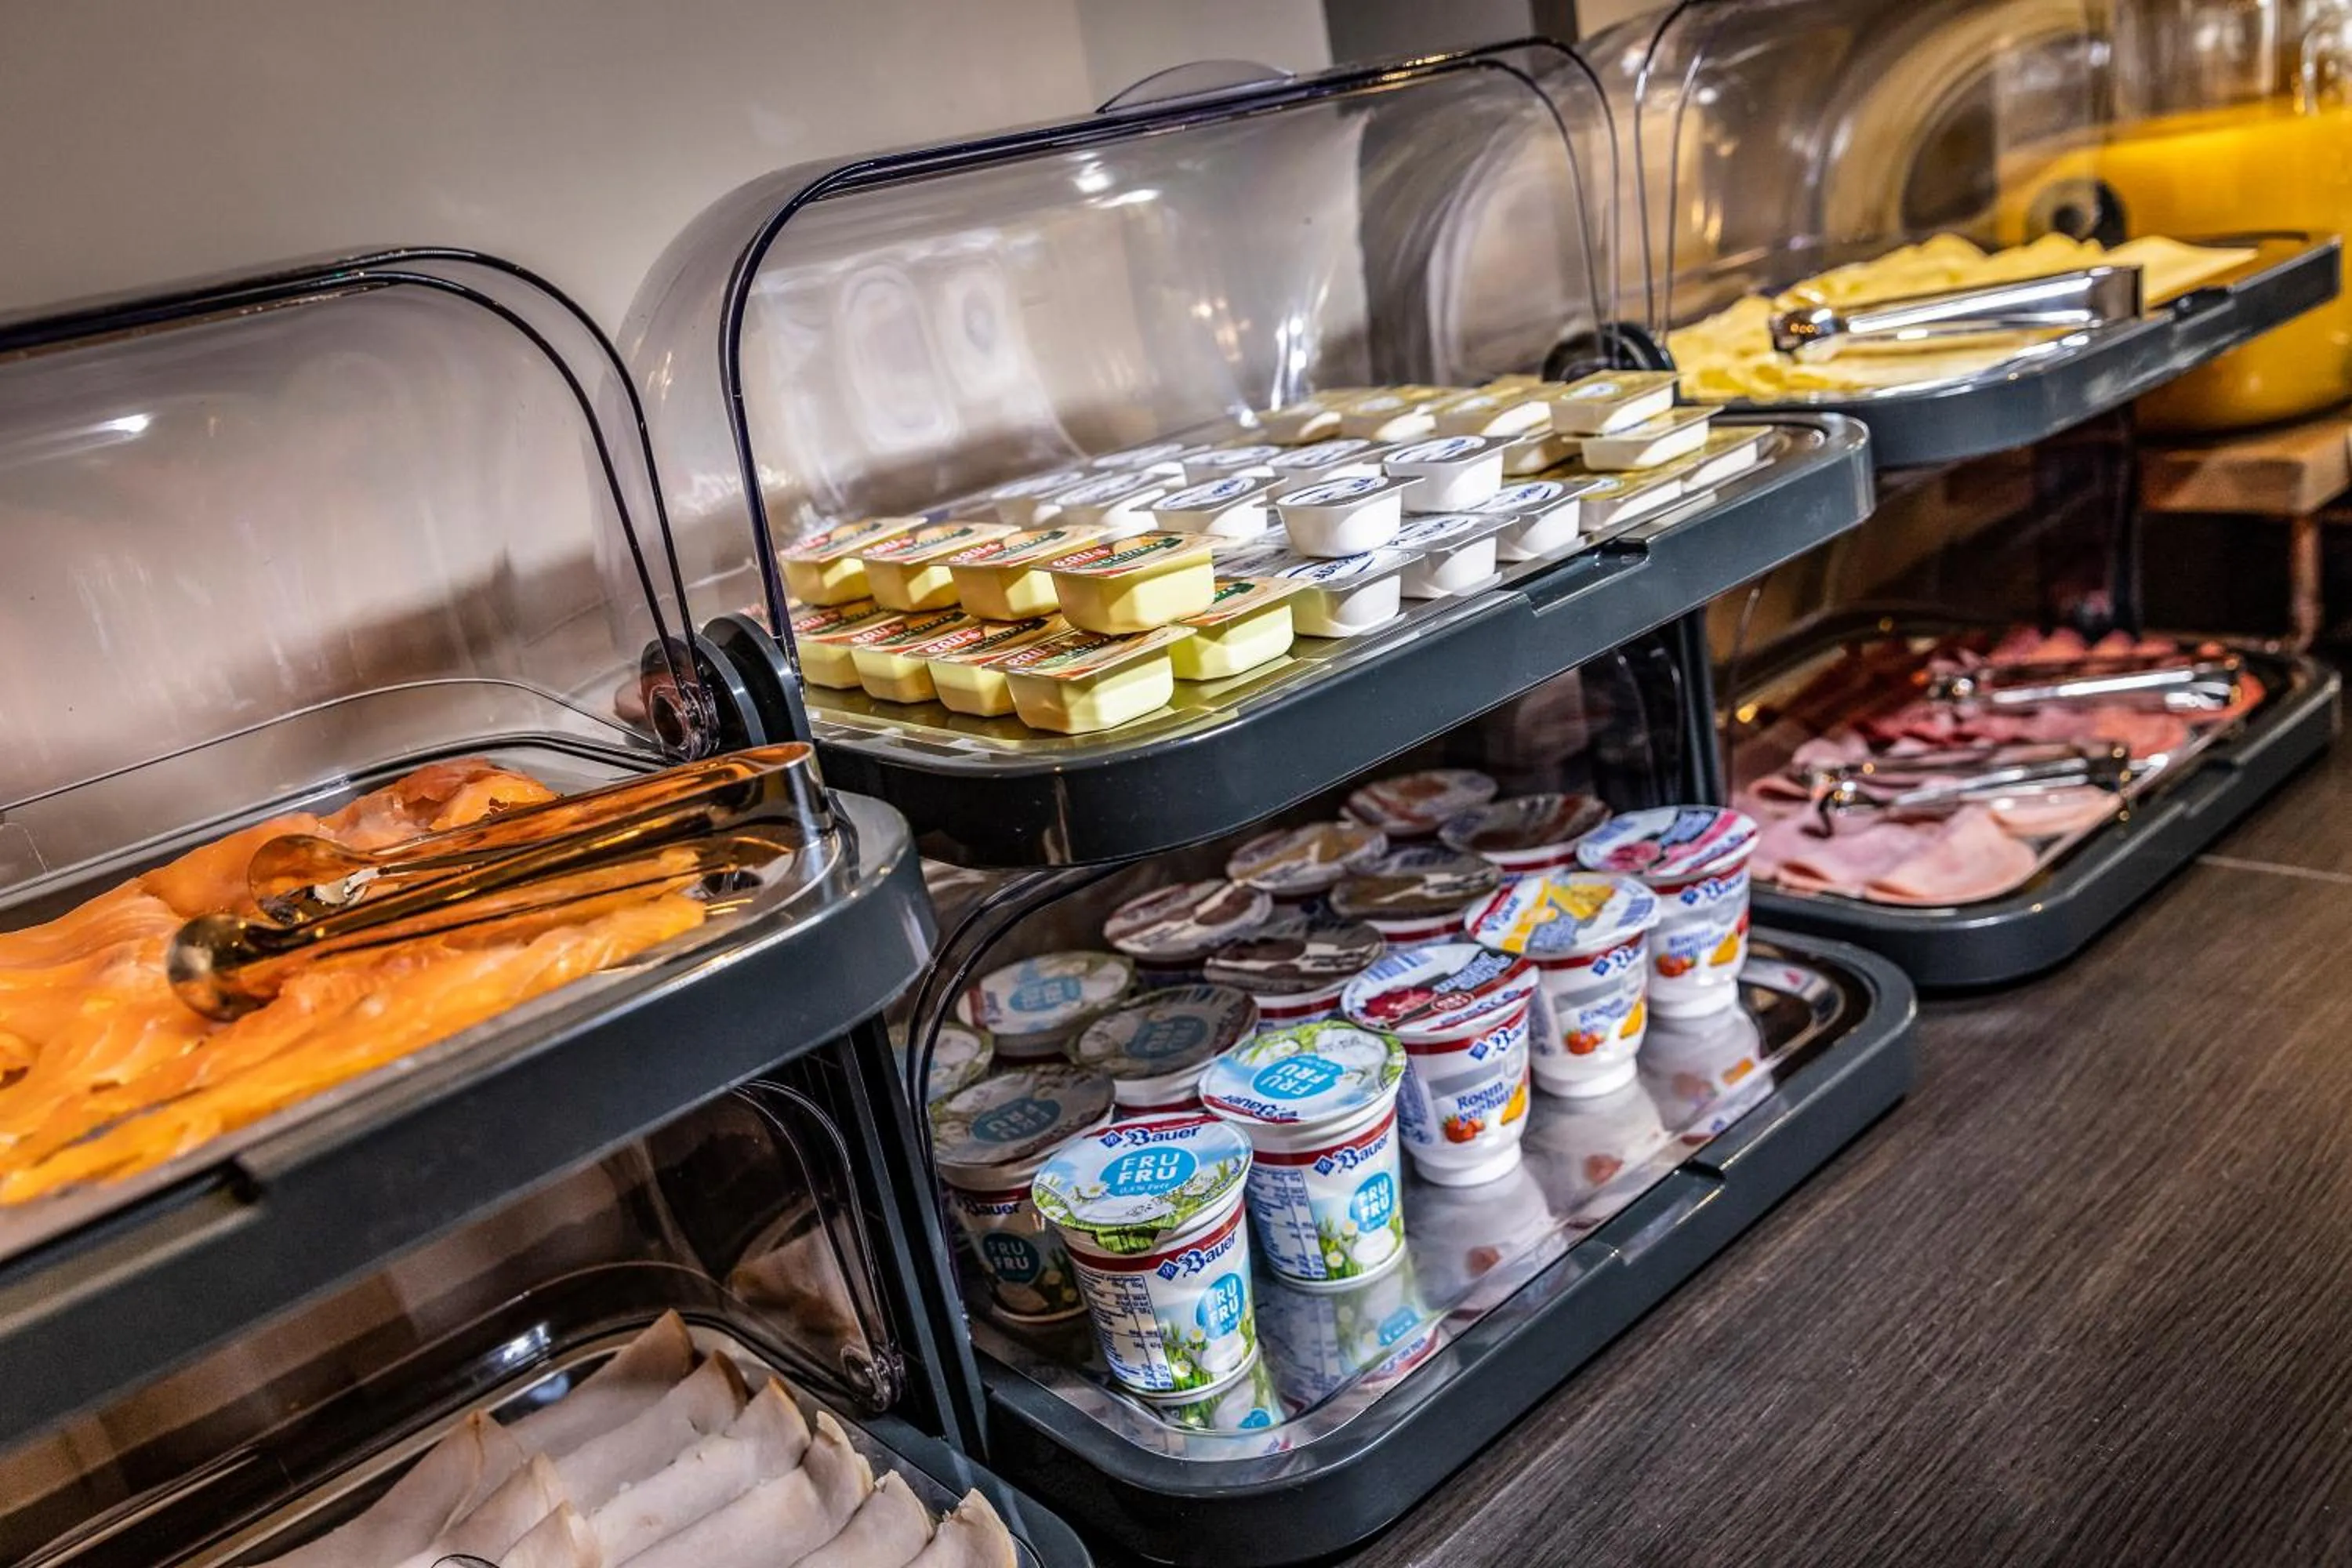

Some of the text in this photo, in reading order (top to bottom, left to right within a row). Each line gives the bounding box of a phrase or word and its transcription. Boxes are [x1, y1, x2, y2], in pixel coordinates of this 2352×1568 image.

[1276, 1063, 1330, 1084] FRU
[1260, 1074, 1314, 1096] FRU
[1457, 1082, 1503, 1110] Room
[1123, 1127, 1201, 1147] Bauer
[1122, 1152, 1181, 1171] FRU
[1334, 1134, 1388, 1174] Bauer
[1116, 1166, 1178, 1185] FRU
[1360, 1193, 1390, 1223] FRU
[993, 1255, 1030, 1270] FRU
[1178, 1231, 1236, 1278] Bauer
[1208, 1295, 1239, 1328] FRU
